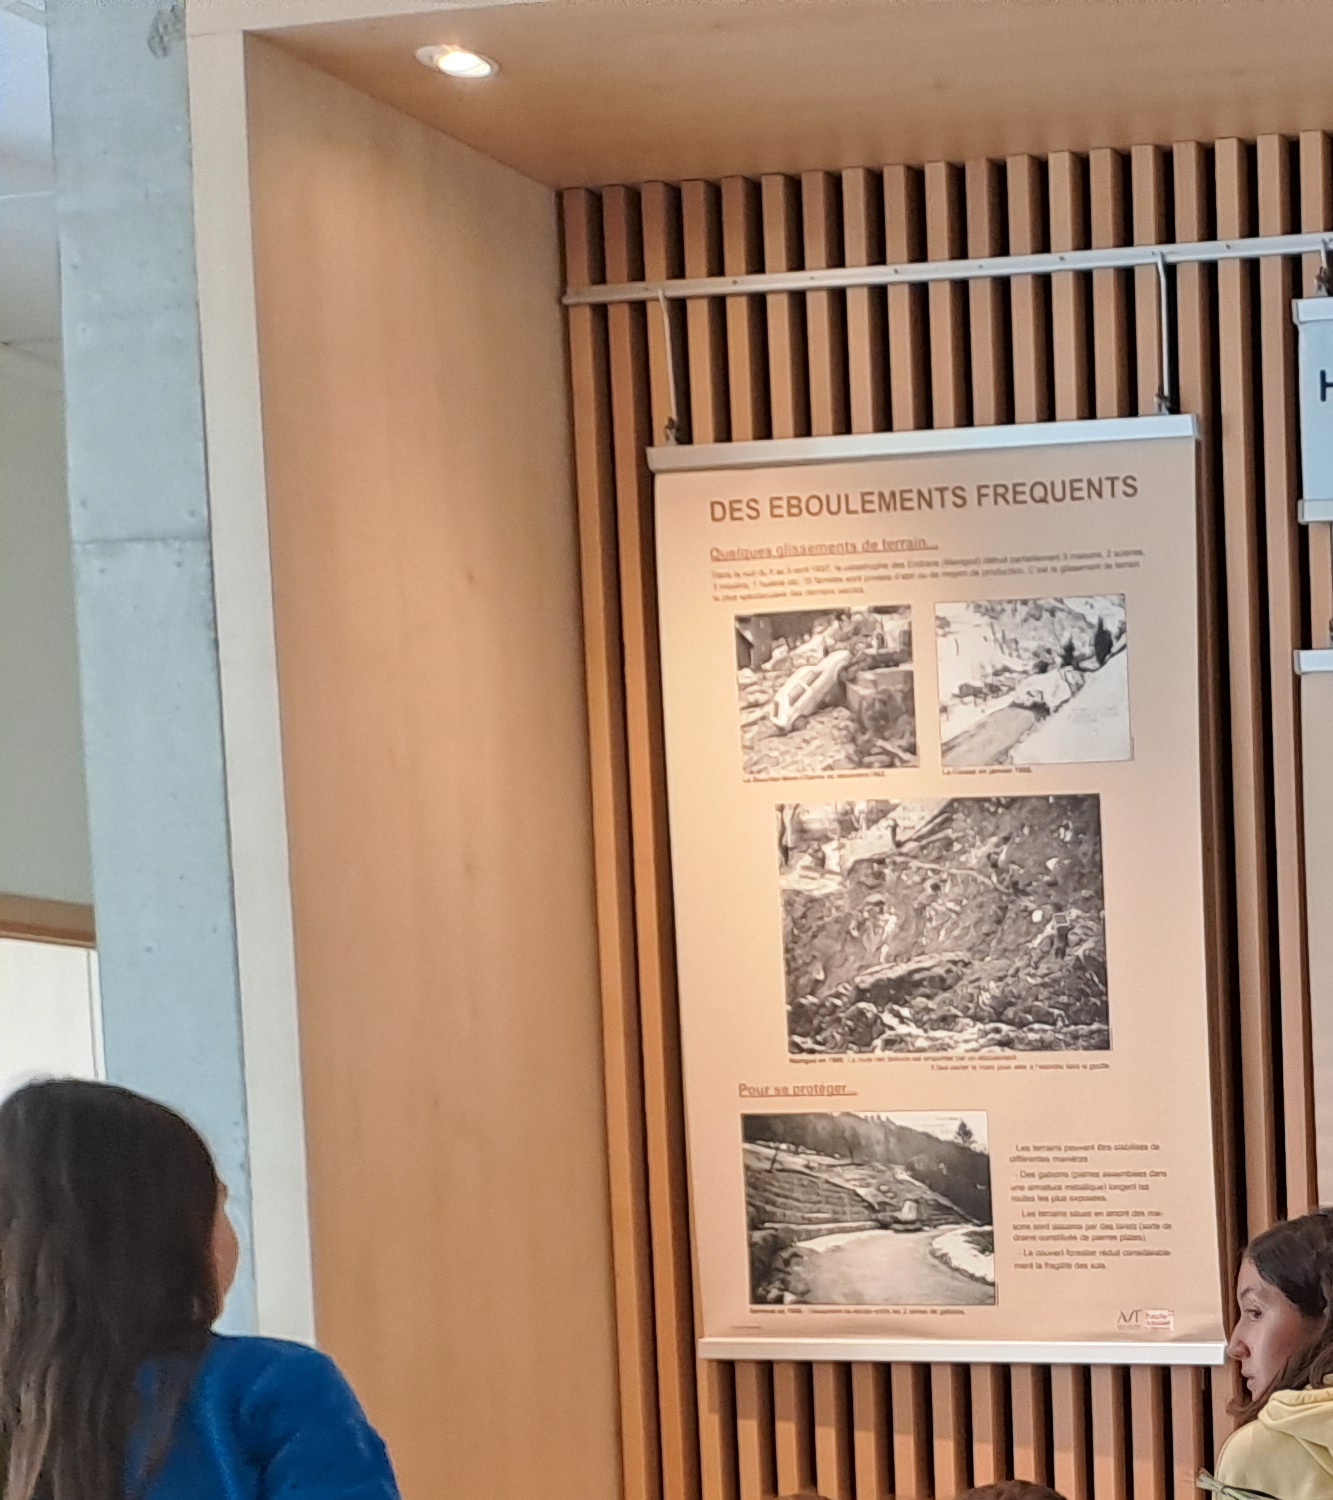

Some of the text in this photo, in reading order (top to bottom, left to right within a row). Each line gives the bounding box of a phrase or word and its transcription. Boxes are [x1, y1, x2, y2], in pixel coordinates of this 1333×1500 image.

[709, 476, 1138, 522] DES EBOULEMENTS FREQUENTS
[861, 539, 878, 552] de
